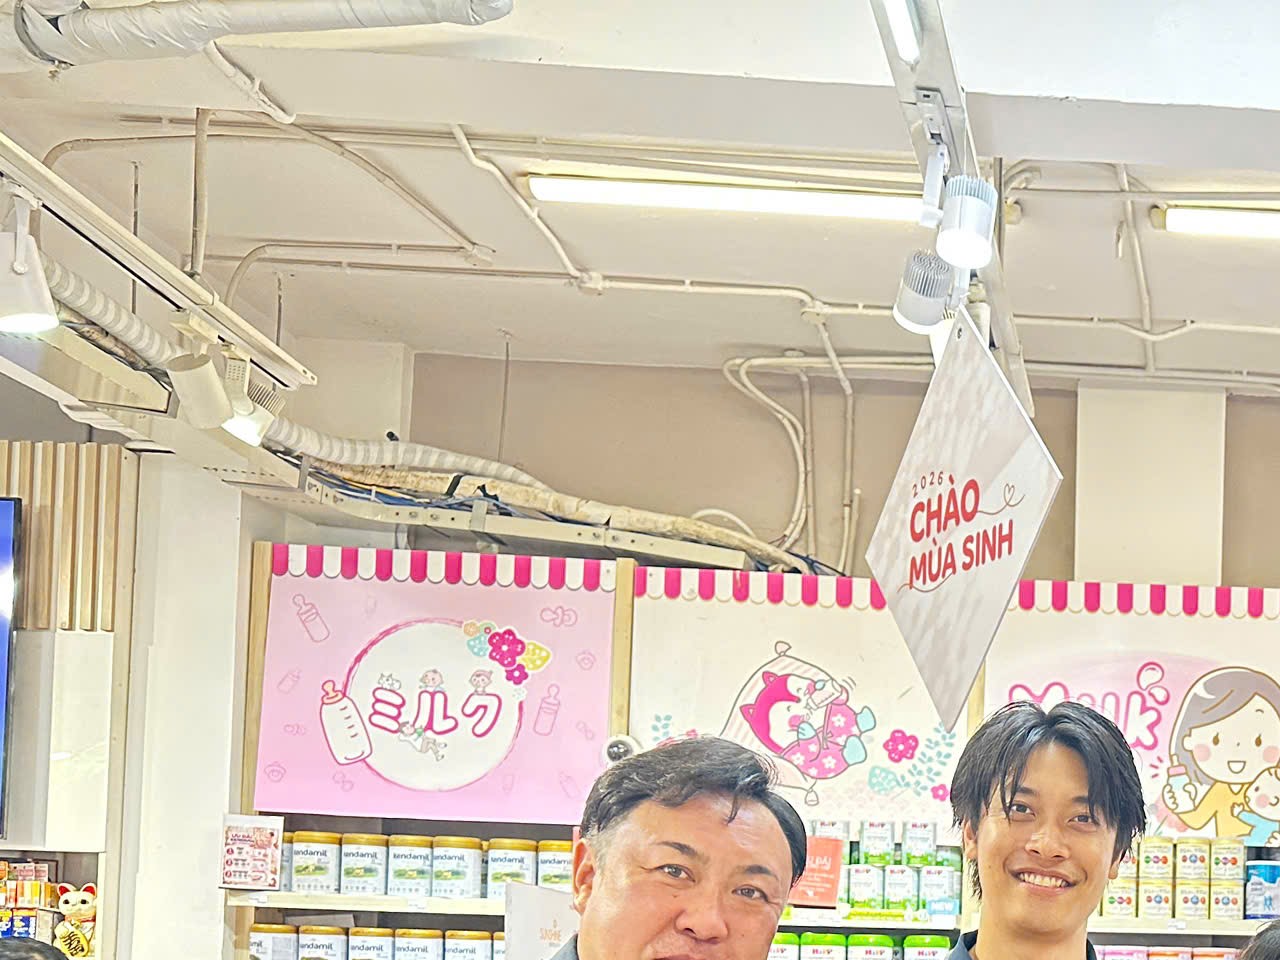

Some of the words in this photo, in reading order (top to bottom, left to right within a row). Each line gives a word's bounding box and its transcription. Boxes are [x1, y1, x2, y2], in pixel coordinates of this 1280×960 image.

[910, 474, 980, 543] CHÀO
[912, 470, 944, 498] 2026
[909, 537, 957, 590] MÙA
[962, 519, 1014, 572] SINH
[368, 686, 503, 738] ミルク
